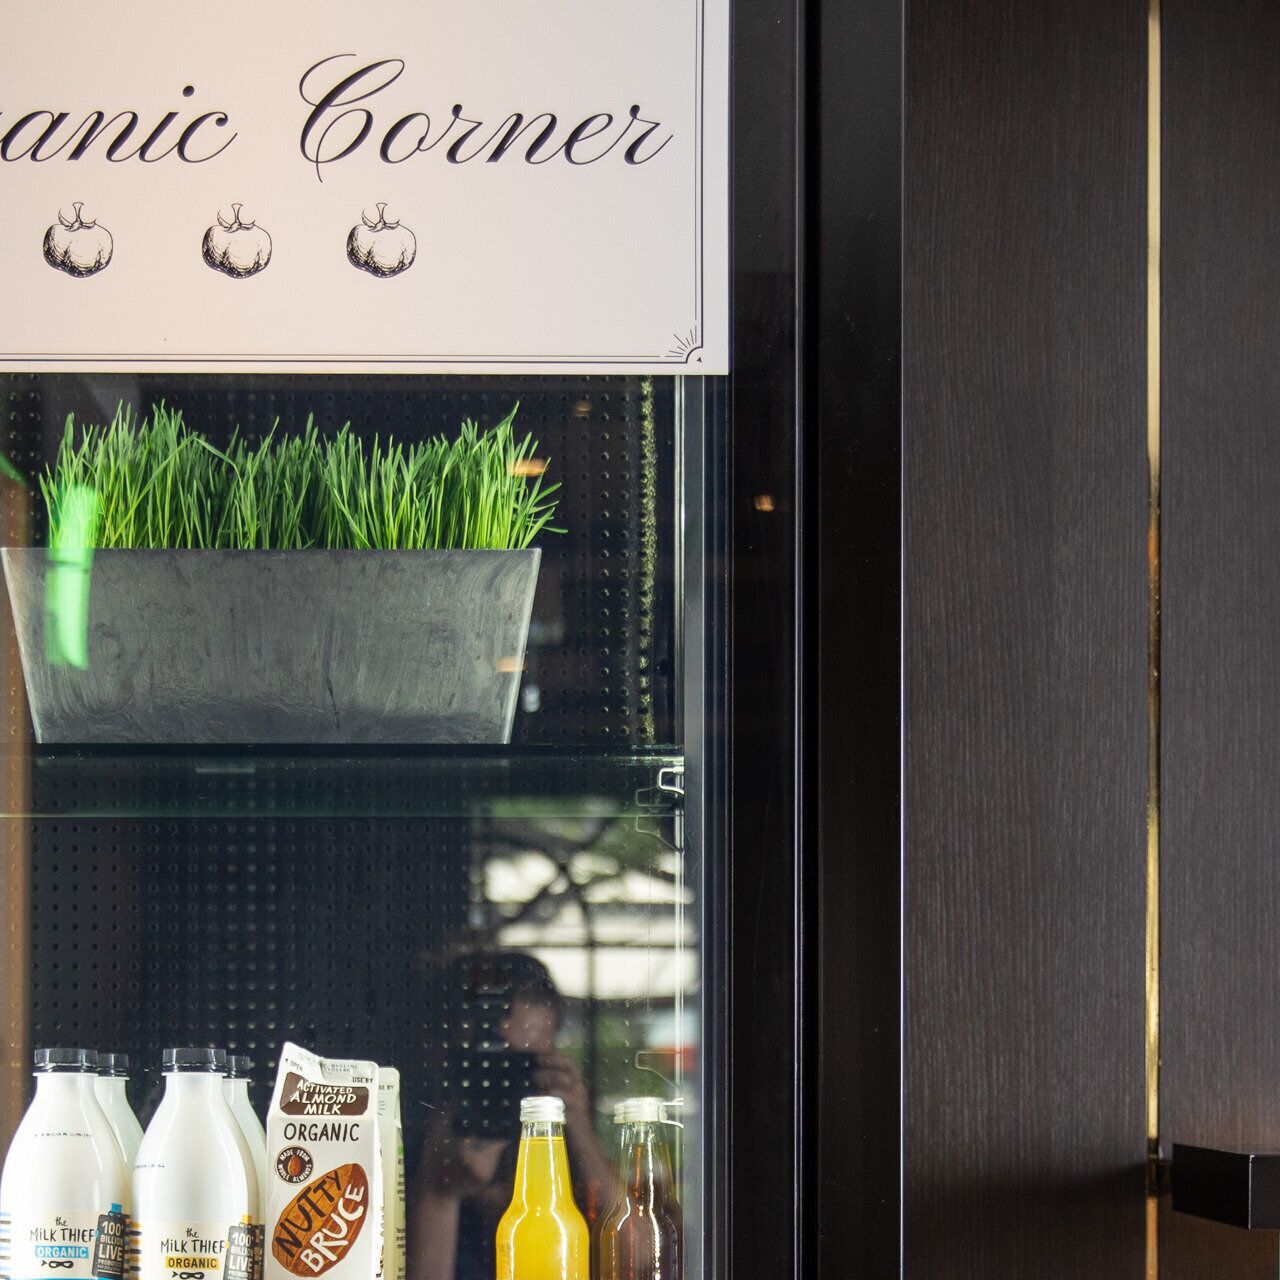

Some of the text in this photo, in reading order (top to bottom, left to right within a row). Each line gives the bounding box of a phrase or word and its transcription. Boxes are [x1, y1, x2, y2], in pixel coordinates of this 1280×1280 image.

[298, 54, 674, 182] Corner
[290, 1060, 304, 1072] OPEN
[297, 1079, 353, 1094] ACTIVATED
[290, 1092, 357, 1104] ALMOND
[303, 1104, 342, 1115] MILK
[284, 1122, 360, 1142] ORGANIC
[279, 1149, 294, 1161] MADE
[296, 1149, 311, 1161] FROM
[55, 1216, 67, 1226] the
[275, 1170, 342, 1259] NUTTY
[60, 1228, 95, 1243] THIEF
[186, 1228, 199, 1238] the
[300, 1184, 365, 1272] BRUCE
[37, 1246, 88, 1258] ORGANIC
[98, 1244, 123, 1261] LIVE
[192, 1239, 225, 1254] THIEF
[168, 1258, 217, 1269] ORGANIC
[228, 1255, 253, 1272] LIVE
